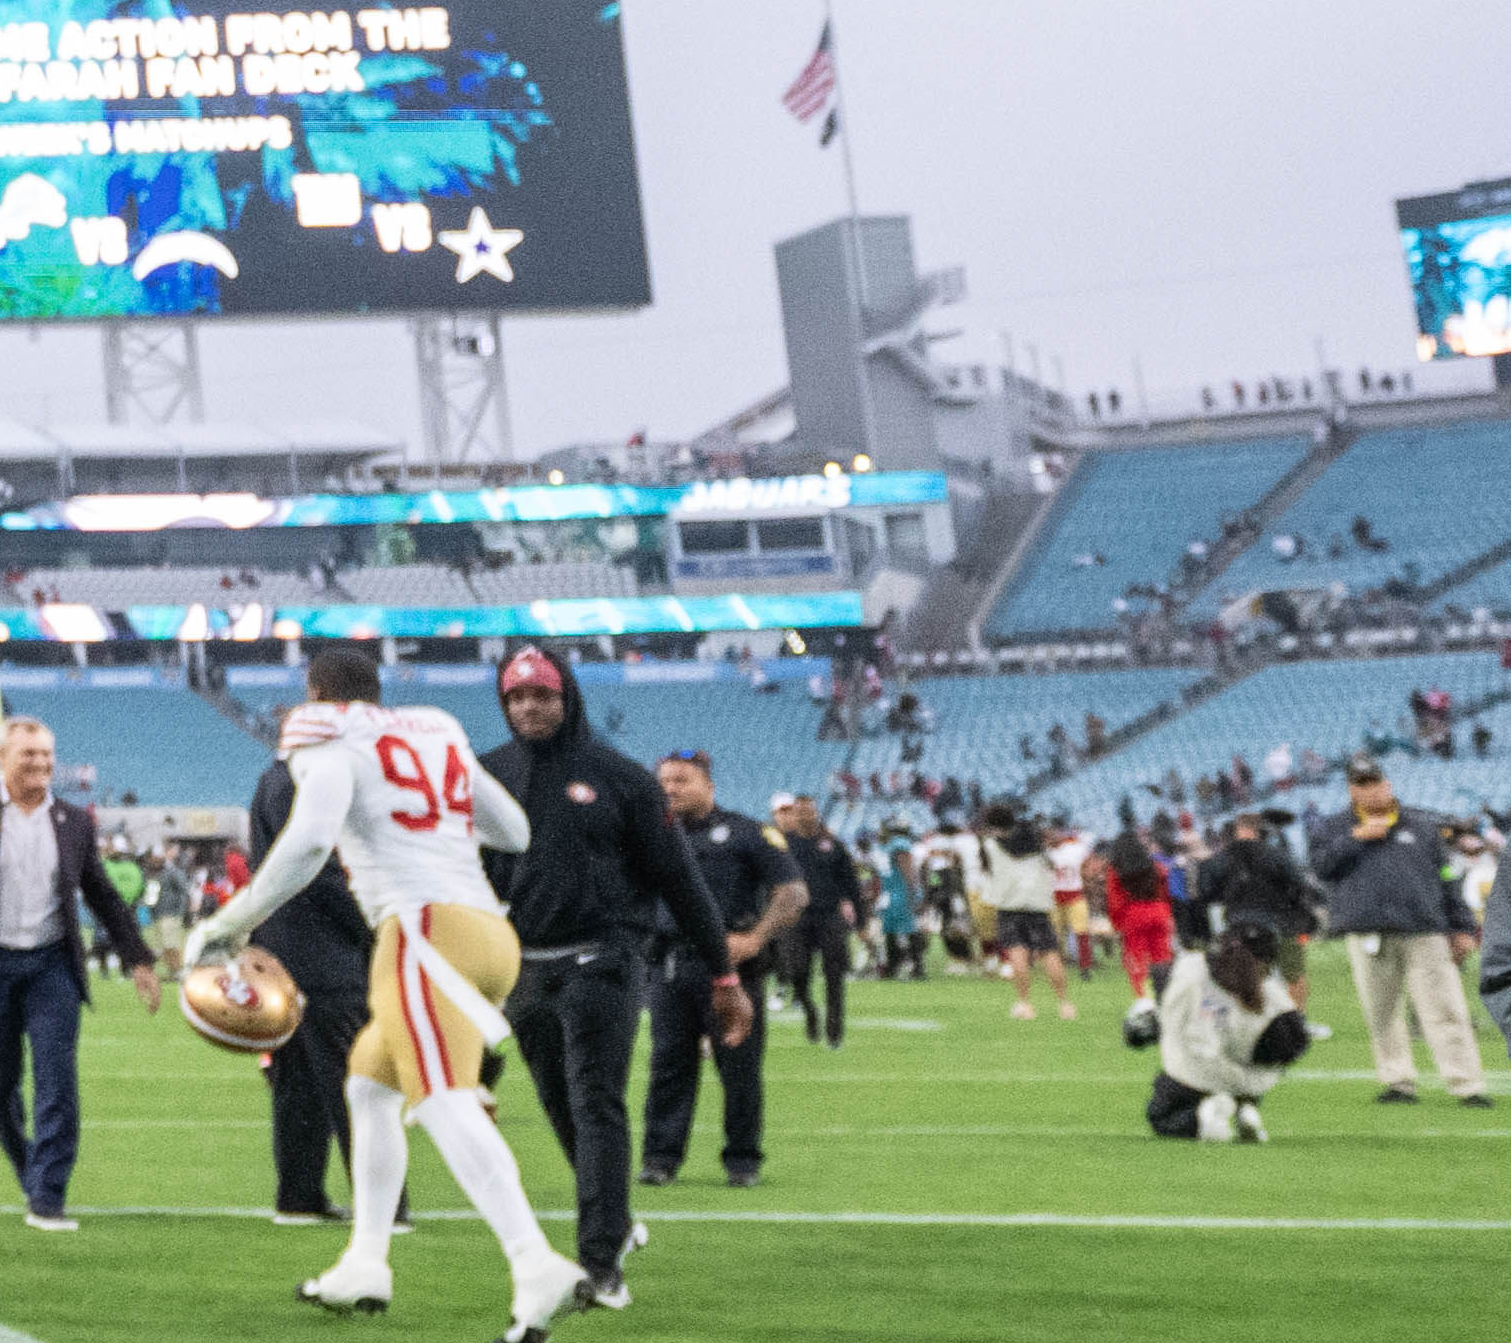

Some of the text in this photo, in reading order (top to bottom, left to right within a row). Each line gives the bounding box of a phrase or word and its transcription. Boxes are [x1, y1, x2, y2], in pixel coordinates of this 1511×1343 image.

[58, 14, 218, 62] ACTION
[226, 10, 352, 55] FROM
[359, 7, 449, 49] THE
[243, 51, 364, 95] DECK
[679, 474, 852, 515] JAGUARS
[374, 733, 474, 838] 94
